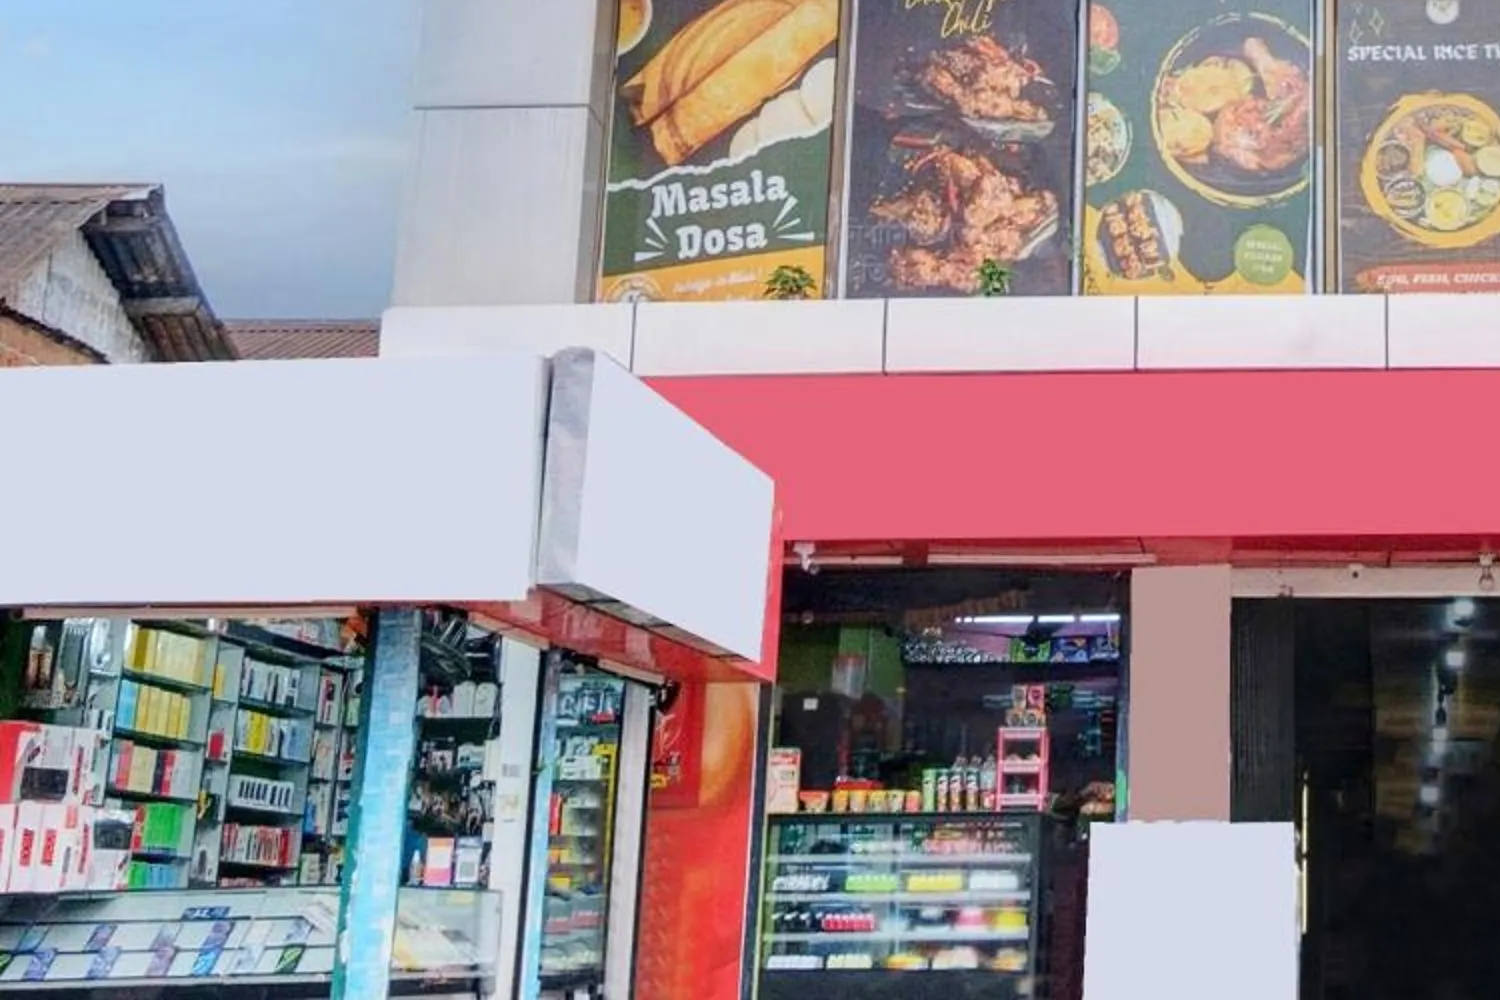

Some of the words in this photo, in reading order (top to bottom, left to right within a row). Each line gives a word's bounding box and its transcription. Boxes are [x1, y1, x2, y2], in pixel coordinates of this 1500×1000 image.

[1347, 44, 1427, 63] SPECIAL
[1434, 45, 1479, 61] RICE
[651, 169, 789, 218] Masala
[675, 223, 768, 259] Dosa
